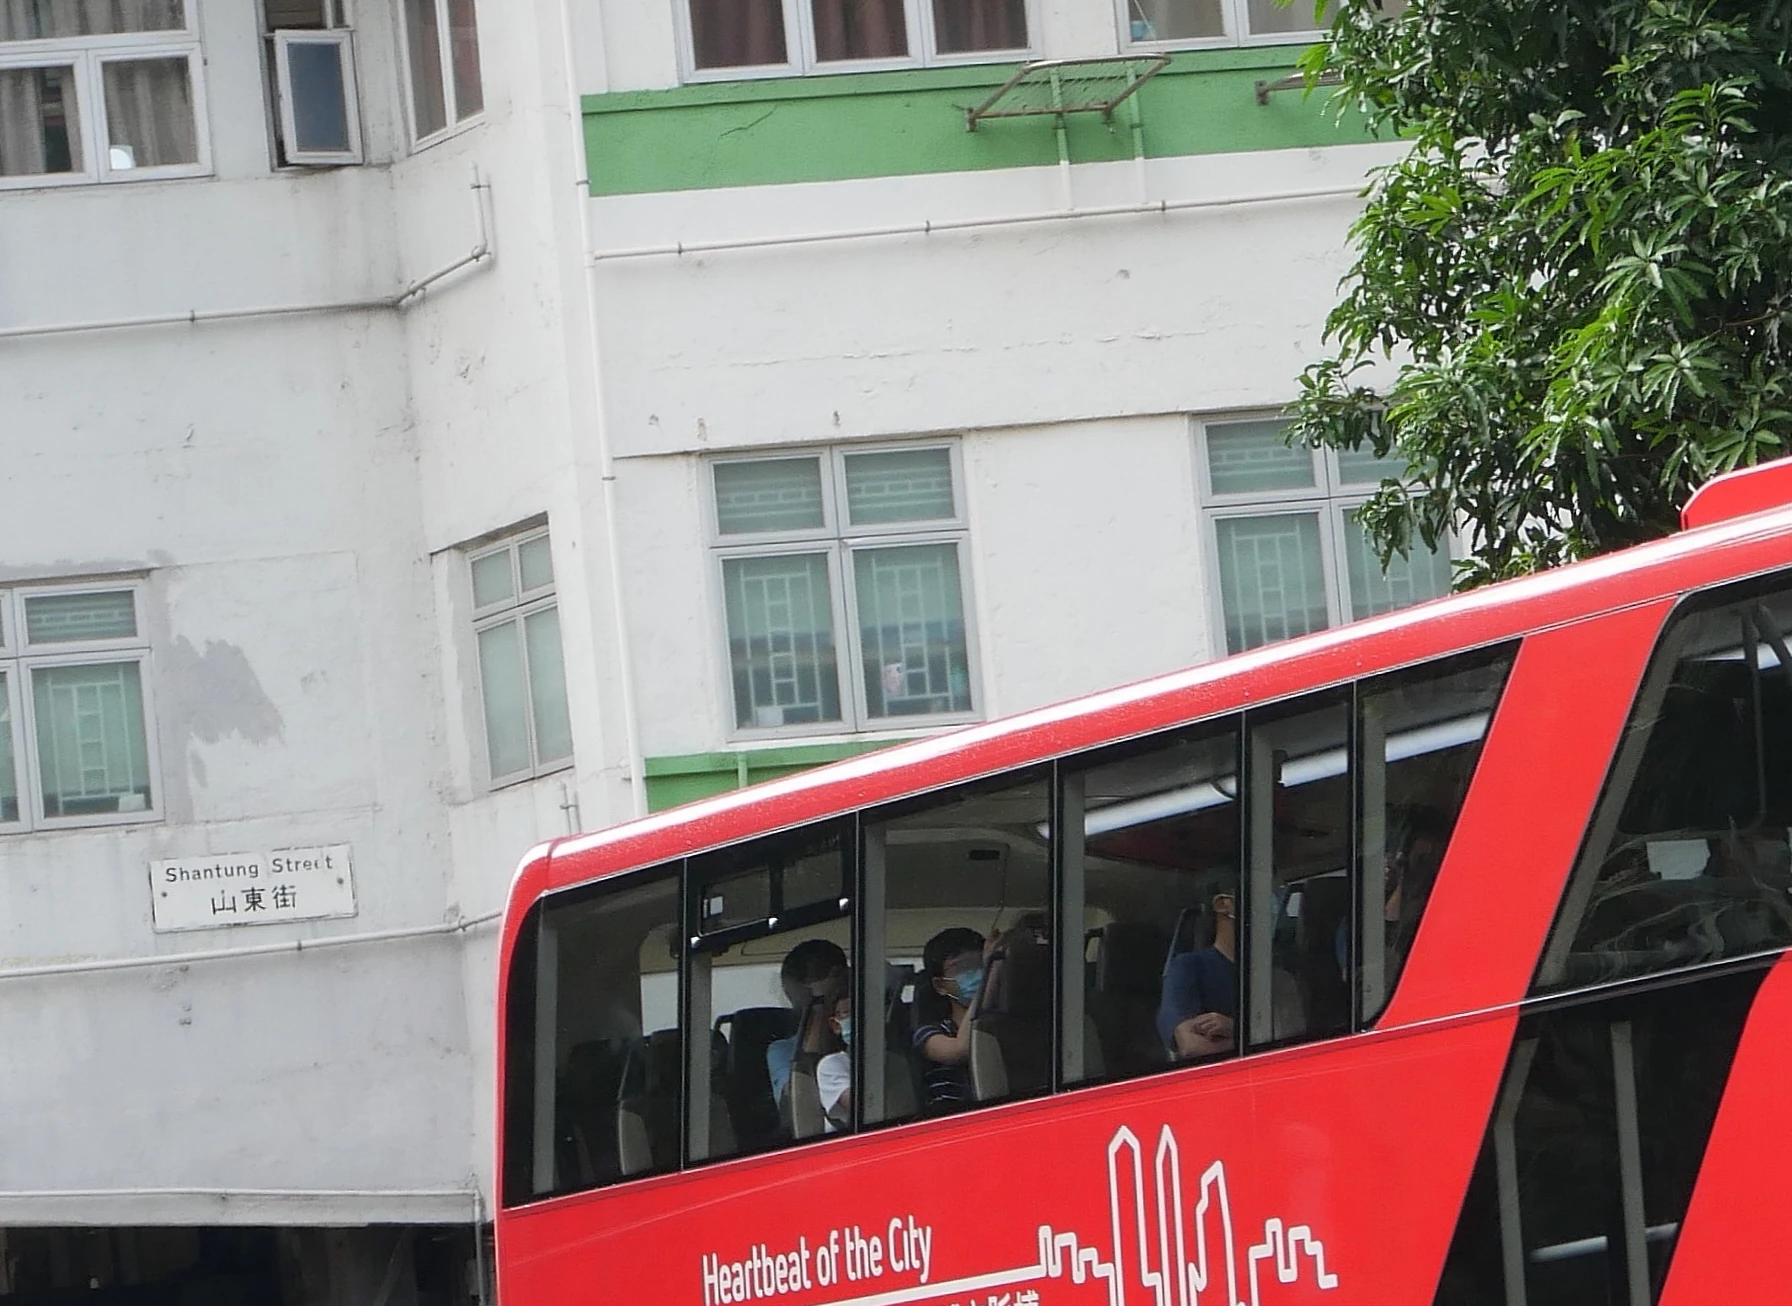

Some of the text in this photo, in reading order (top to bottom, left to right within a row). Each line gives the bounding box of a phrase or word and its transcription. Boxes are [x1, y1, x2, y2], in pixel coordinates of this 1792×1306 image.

[165, 863, 259, 882] Shantung
[211, 884, 297, 915] 山東街
[816, 1229, 840, 1288] of
[844, 1225, 884, 1282] the
[888, 1213, 932, 1285] City
